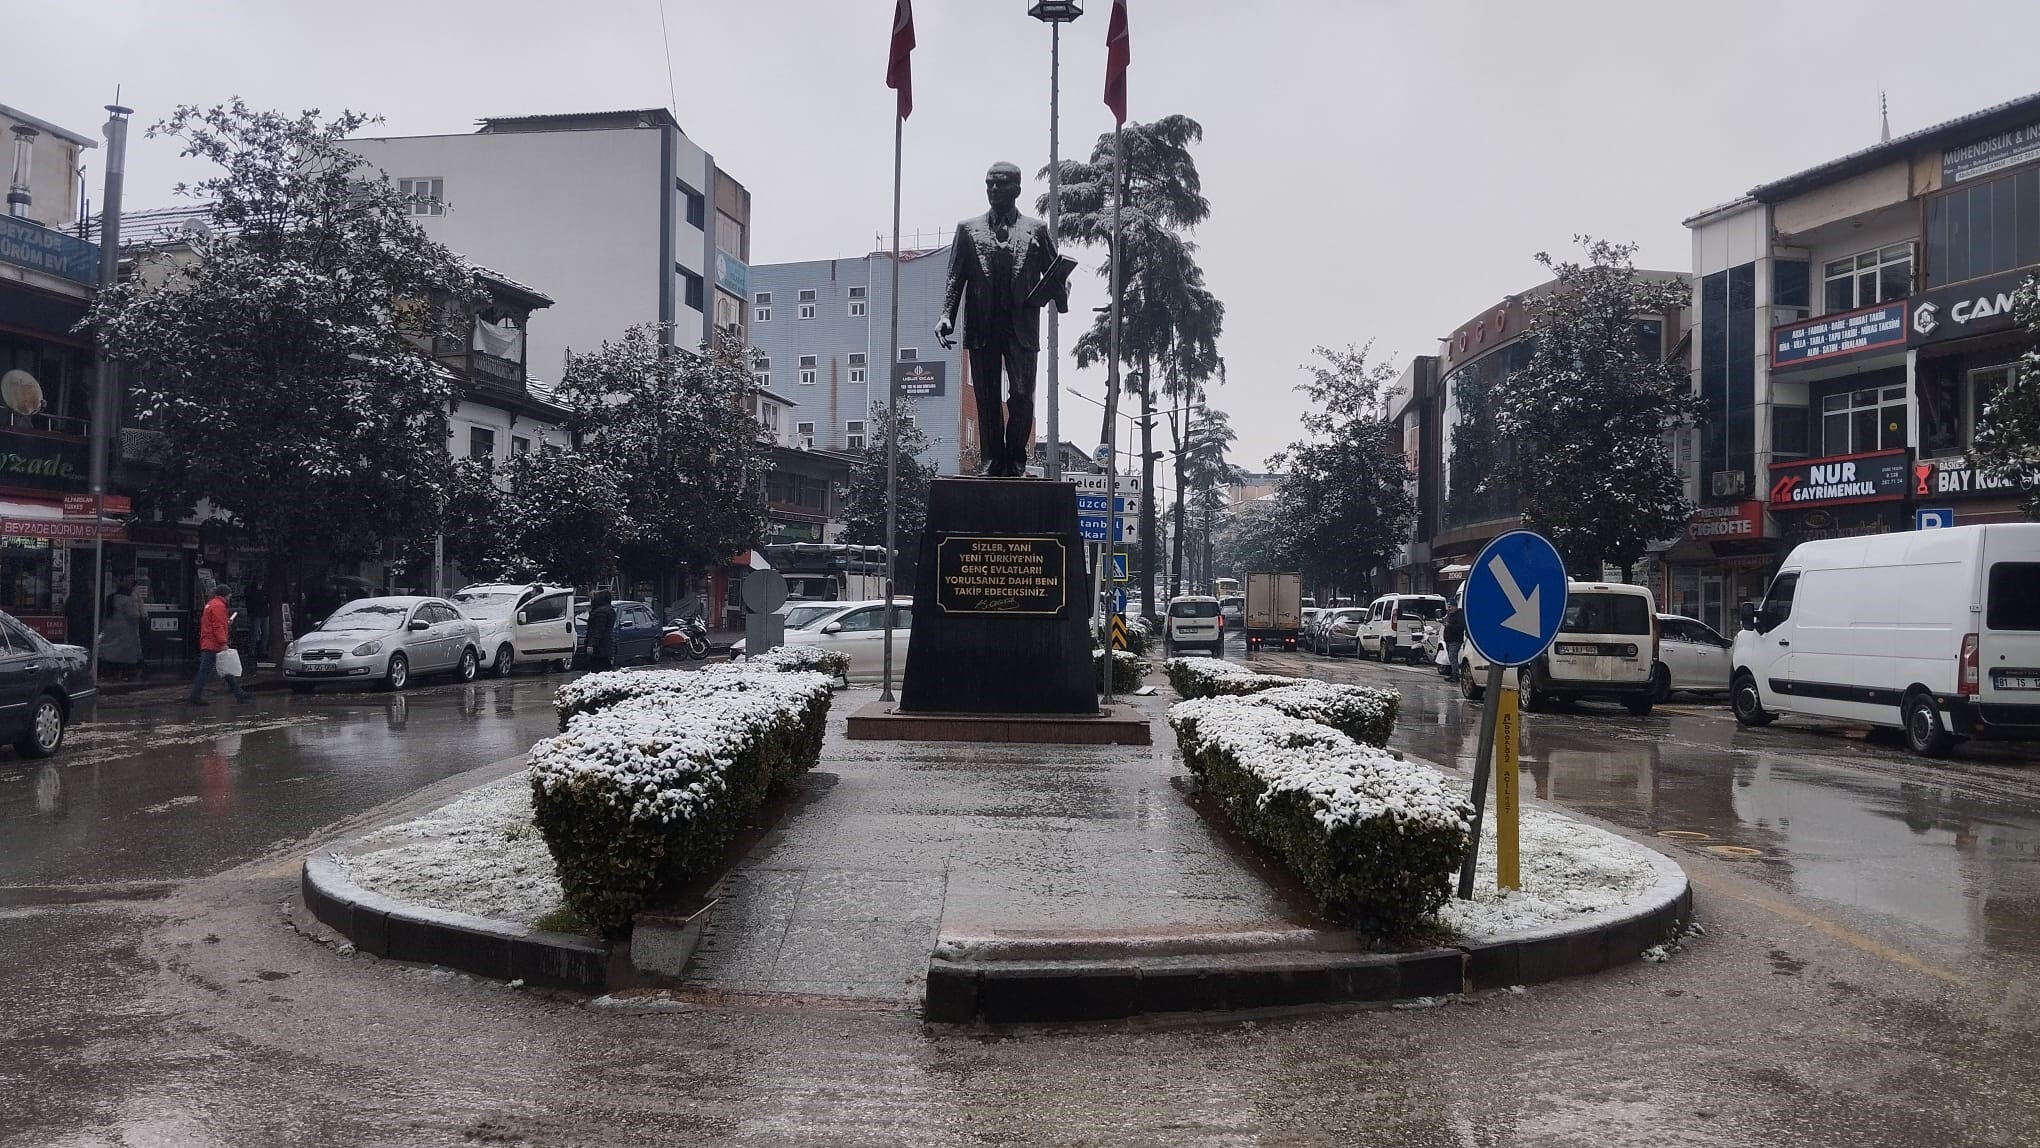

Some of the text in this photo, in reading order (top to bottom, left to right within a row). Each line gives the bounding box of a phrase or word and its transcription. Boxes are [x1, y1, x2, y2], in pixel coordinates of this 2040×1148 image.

[1944, 132, 2012, 166] MÜHENDİSLİK
[0, 221, 60, 251] BEYZADE
[0, 238, 42, 266] ÜRÜM
[1810, 462, 1856, 485] NUR
[1069, 478, 1120, 489] eledie
[1939, 470, 1971, 492] BAY
[1793, 480, 1876, 501] GAYRİMENKUL
[1079, 499, 1107, 509] üzce
[5, 522, 50, 535] BEYZADE
[50, 523, 84, 537] DÜRÜM
[1081, 520, 1120, 529] tanbl
[1689, 517, 1752, 539] ÇİĞKÖFTE
[972, 541, 1031, 552] SİZLER, YANİ
[960, 553, 1044, 564] YENİ TÜRKİYE'NİN
[961, 565, 988, 575] GENÇ
[945, 576, 1058, 586] YORULSANIZ DAHİ BENİ
[954, 586, 1048, 597] TAKİP EDECEKSİNİZ.
[1999, 678, 2008, 687] 81
[2016, 678, 2026, 688] TS
